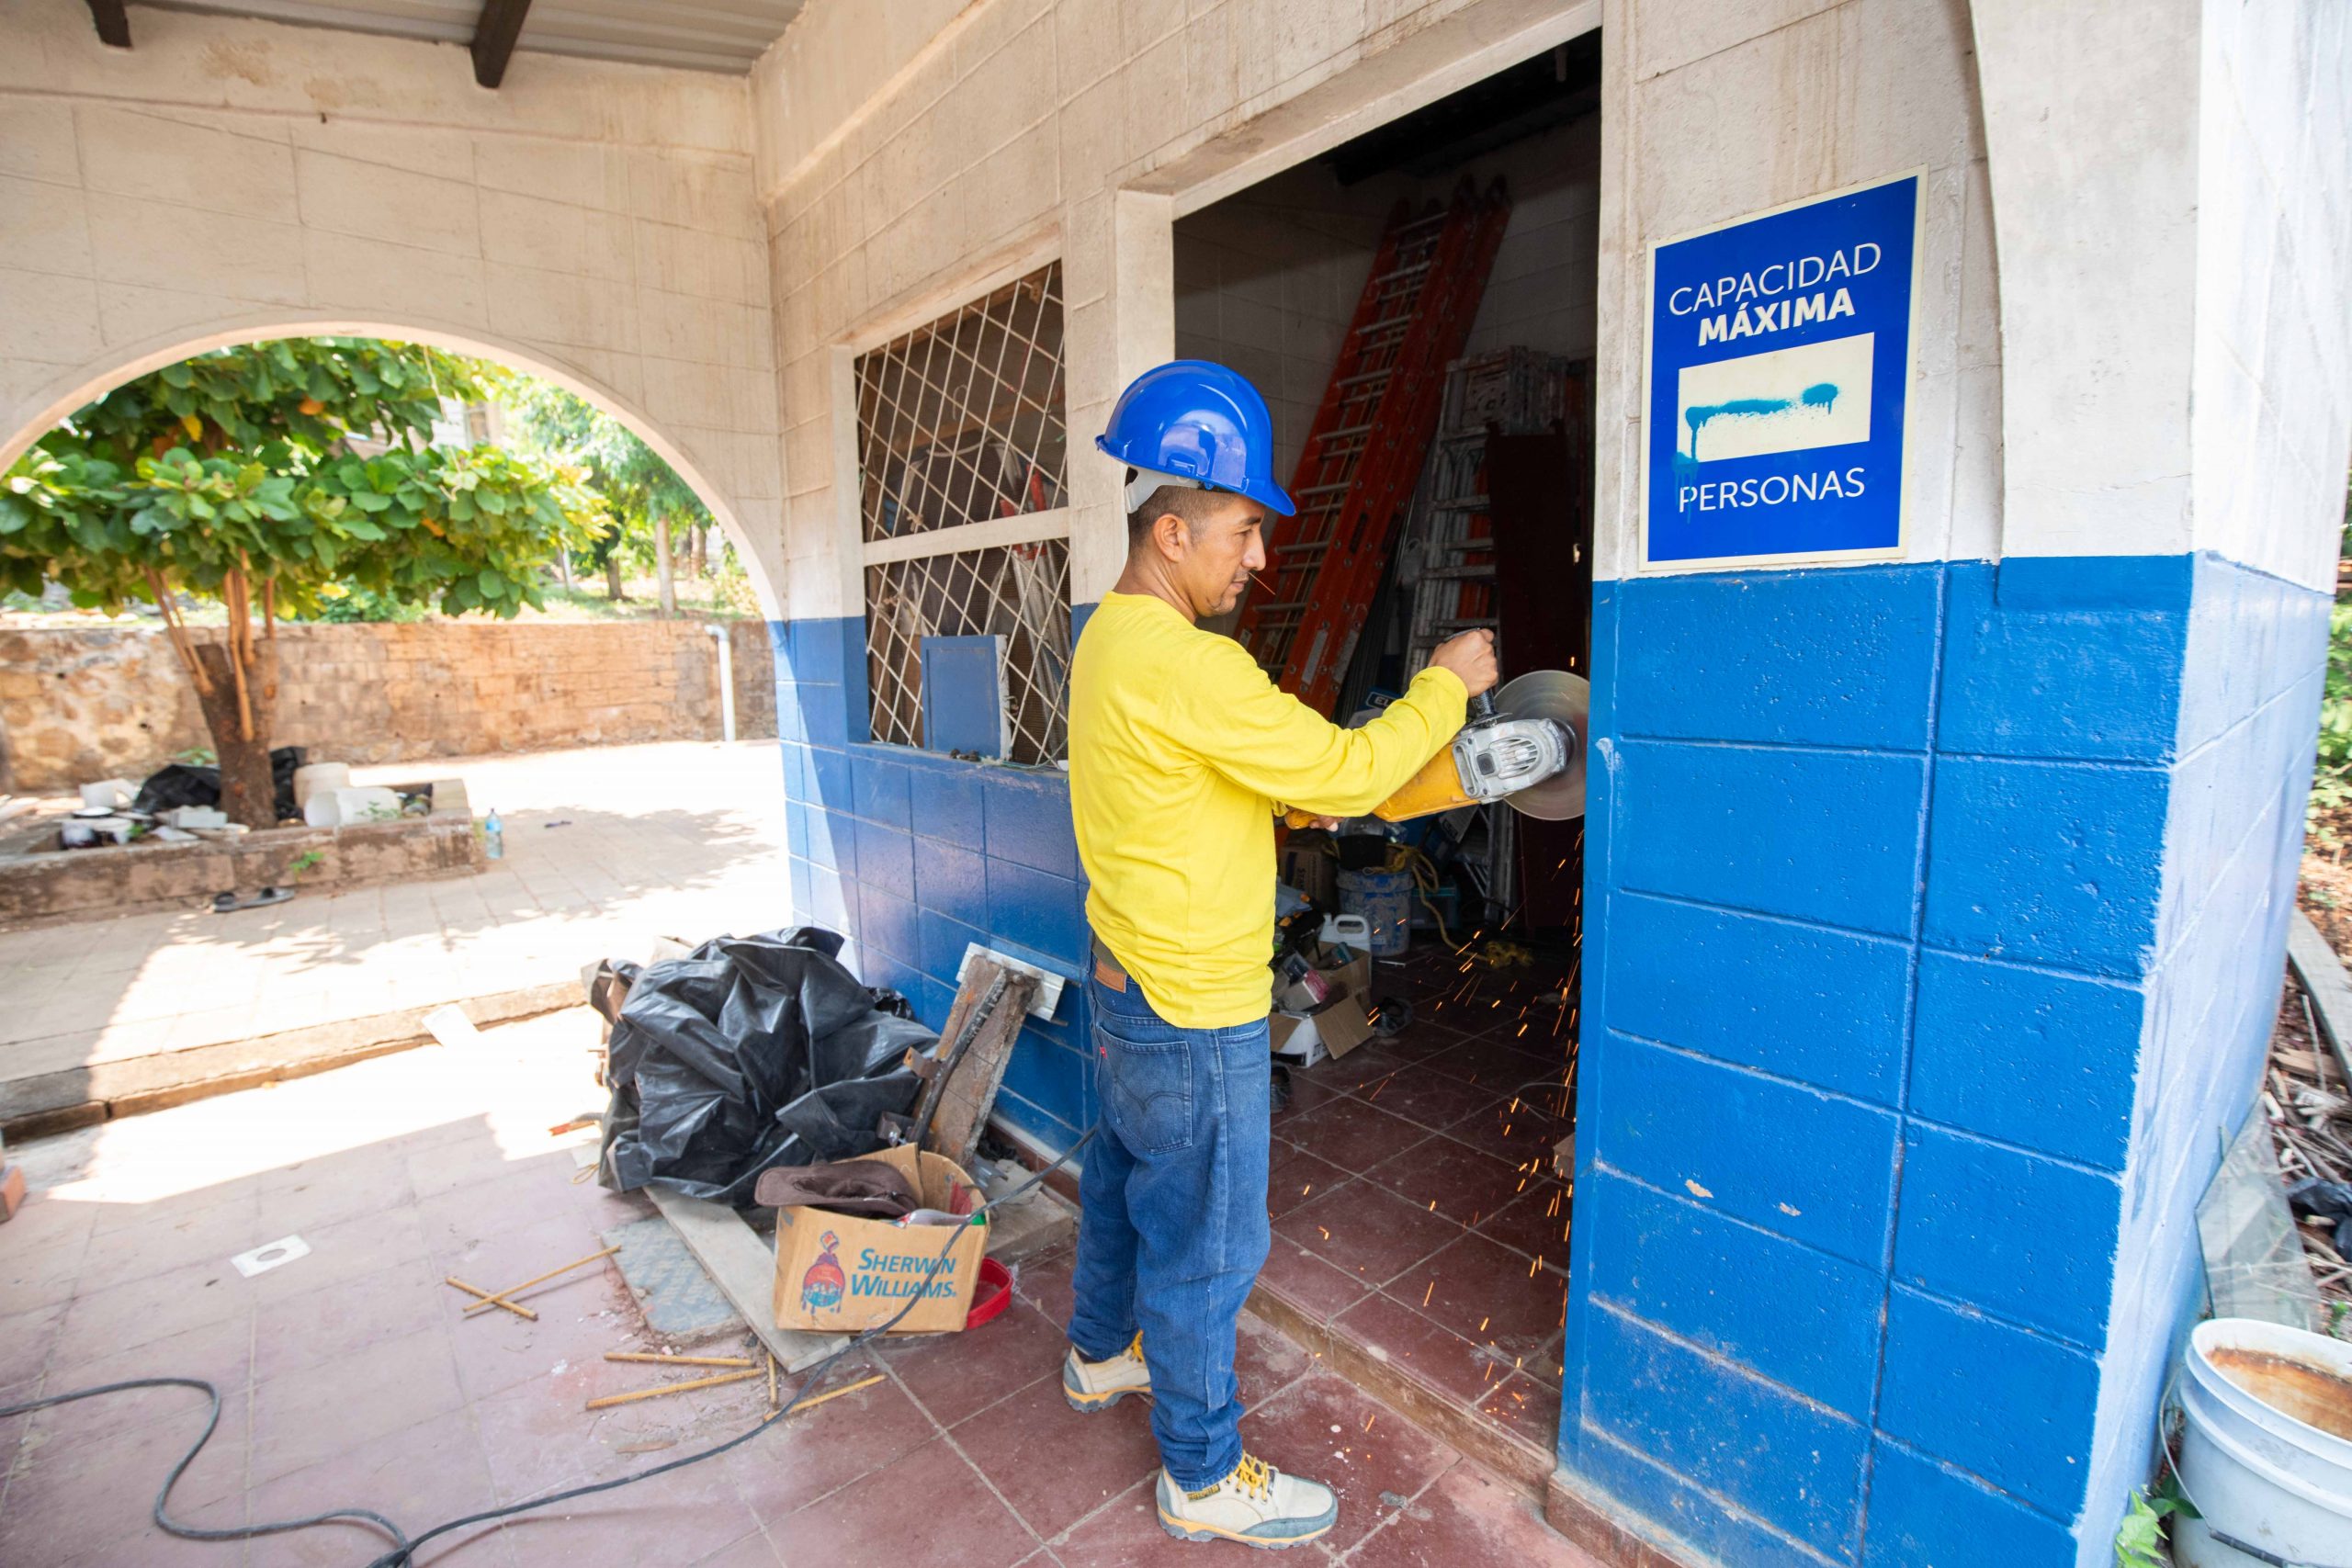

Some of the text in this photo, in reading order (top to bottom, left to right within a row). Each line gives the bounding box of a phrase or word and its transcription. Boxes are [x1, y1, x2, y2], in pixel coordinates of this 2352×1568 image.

[1669, 243, 1882, 316] CAPACIDAD
[1698, 288, 1856, 347] MÁXIMA
[1679, 467, 1865, 513] PERSONAS
[858, 1247, 956, 1275] SHERWN
